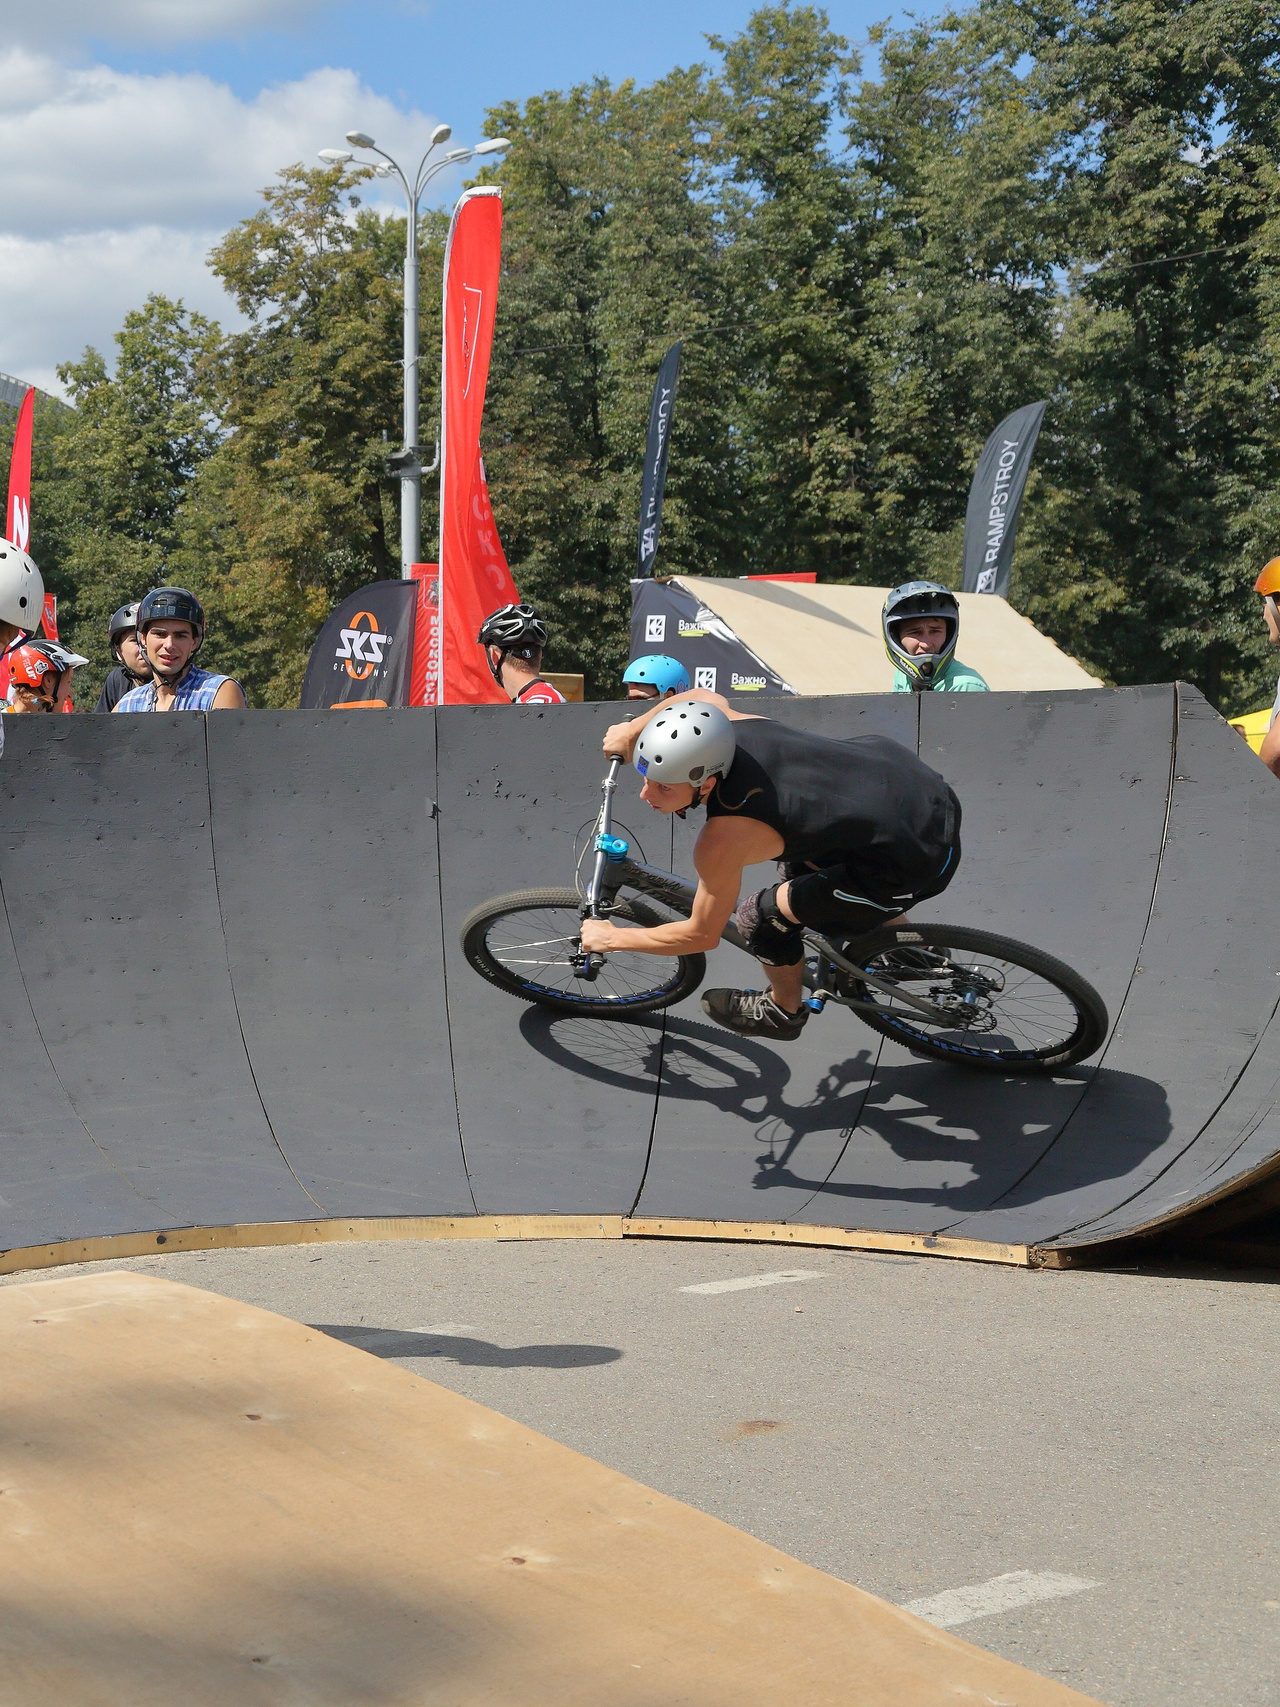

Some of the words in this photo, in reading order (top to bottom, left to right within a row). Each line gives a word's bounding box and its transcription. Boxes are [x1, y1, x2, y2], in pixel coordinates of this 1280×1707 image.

[985, 439, 1019, 563] RAMPSTROY
[333, 662, 388, 678] GERMANY
[731, 672, 767, 685] Важно
